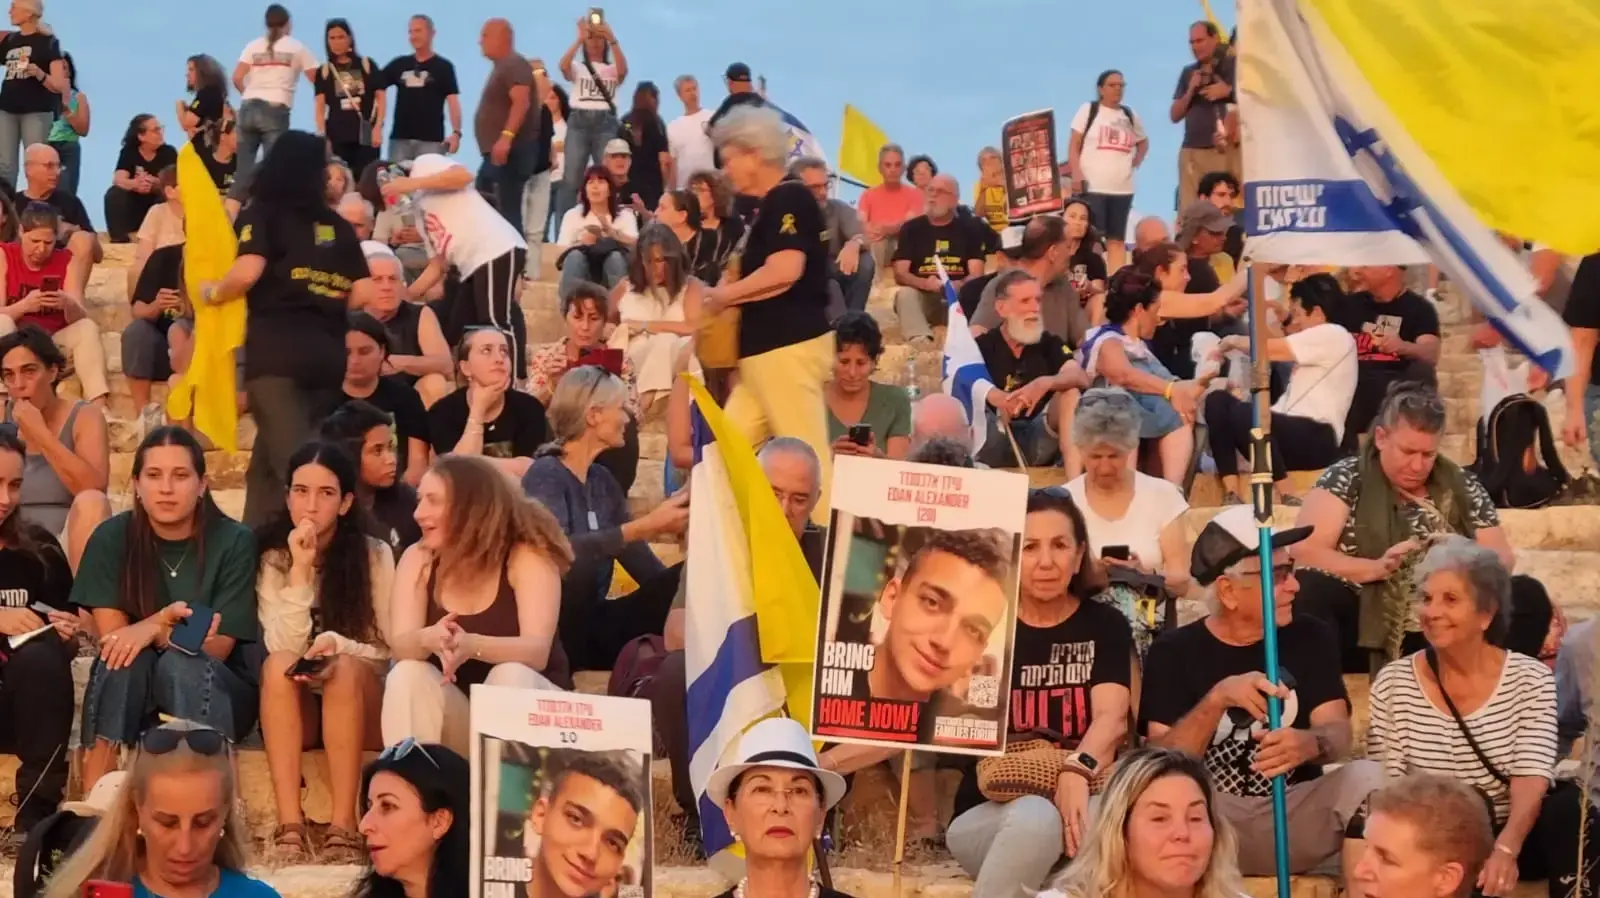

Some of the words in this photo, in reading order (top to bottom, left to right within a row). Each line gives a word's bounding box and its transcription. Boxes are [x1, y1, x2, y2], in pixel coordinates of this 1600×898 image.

[887, 487, 913, 502] EDAN
[914, 490, 970, 509] ALEXANDER
[823, 641, 875, 671] BRING
[820, 668, 854, 696] HIM
[1021, 664, 1064, 686] הביתה
[528, 713, 551, 727] EDAN
[819, 699, 865, 726] HOME
[869, 701, 920, 732] NOW!
[484, 856, 533, 882] BRING
